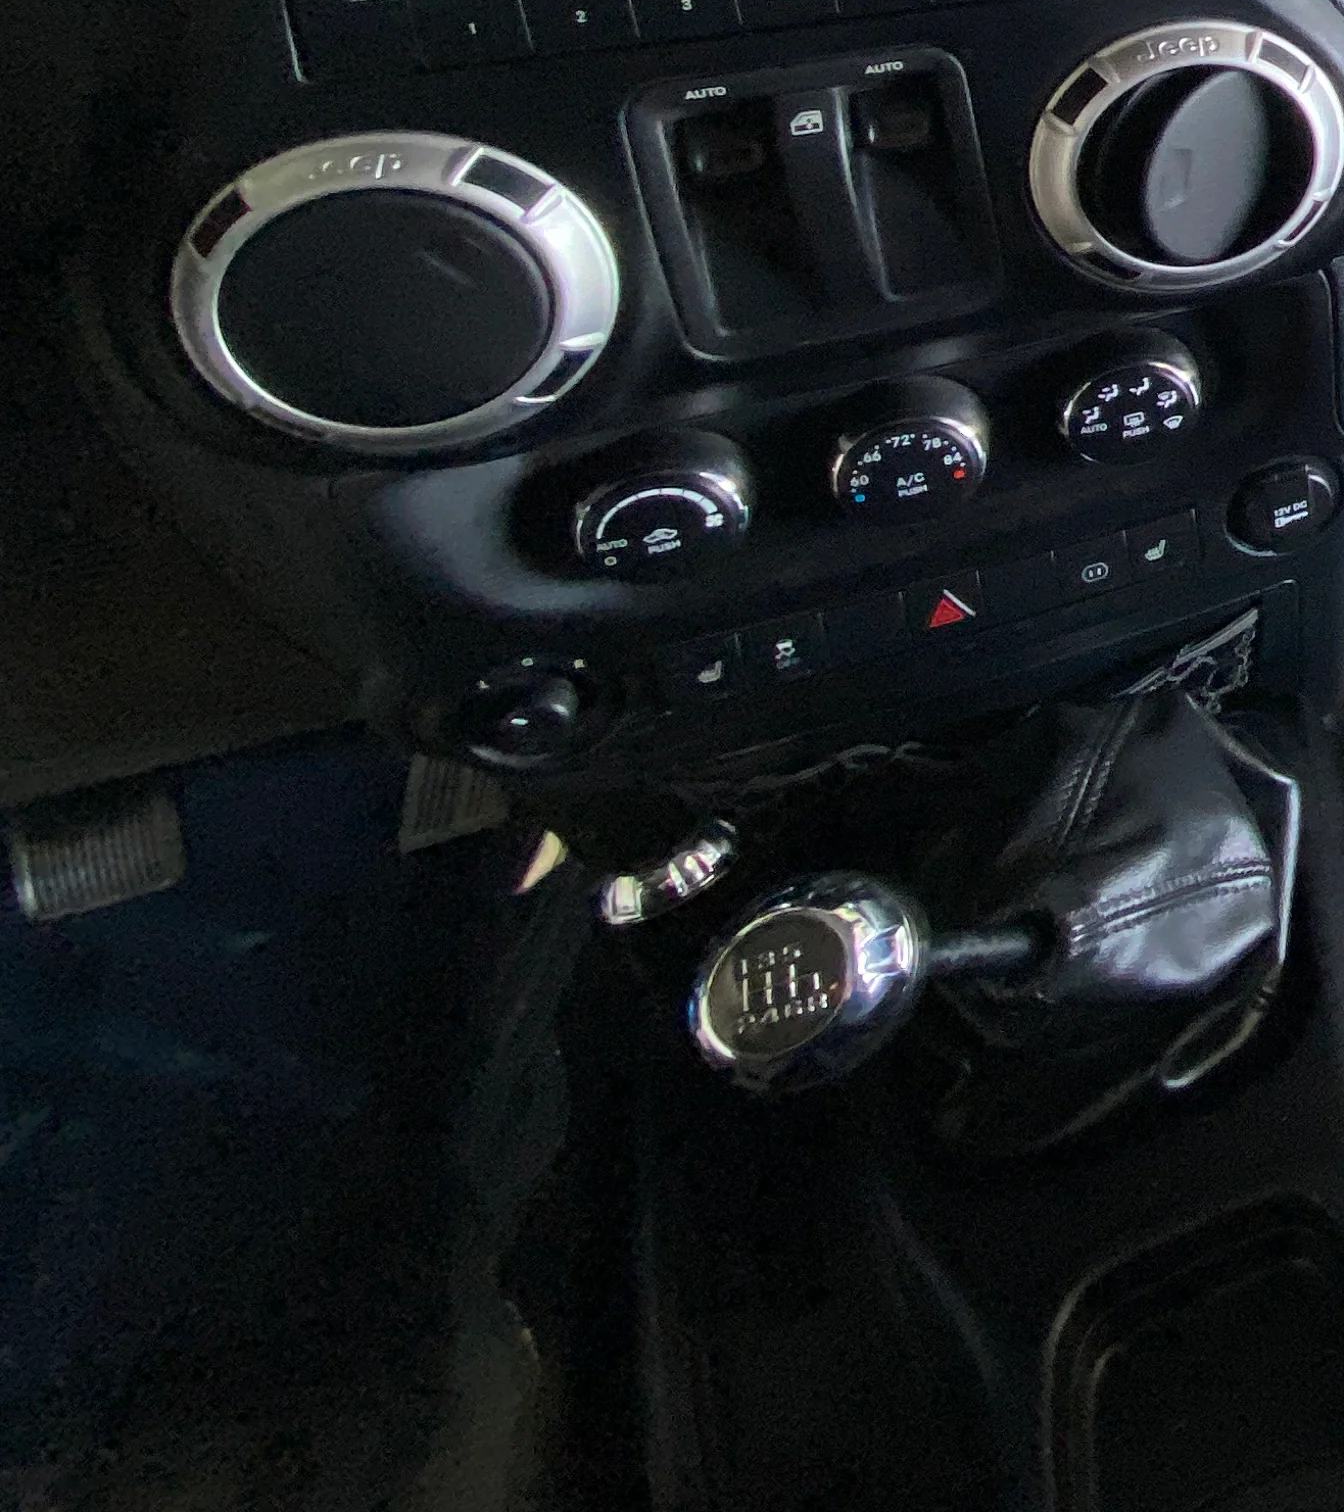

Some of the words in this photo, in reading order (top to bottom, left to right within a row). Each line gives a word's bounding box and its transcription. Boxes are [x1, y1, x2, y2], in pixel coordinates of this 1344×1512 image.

[574, 9, 589, 24] 2
[468, 21, 477, 35] 1
[1136, 36, 1220, 63] Jeep
[864, 61, 904, 75] AUTO
[684, 86, 728, 101] AUTO
[1080, 422, 1108, 436] AUTO
[1122, 425, 1150, 439] PUSH
[890, 434, 912, 449] 72
[922, 437, 942, 451] 78
[863, 450, 882, 464] 66
[943, 451, 963, 466] 84
[849, 474, 870, 487] 60
[896, 472, 925, 488] A/C
[897, 484, 928, 498] PUSH
[1274, 505, 1292, 517] 12V
[1293, 499, 1308, 511] DC
